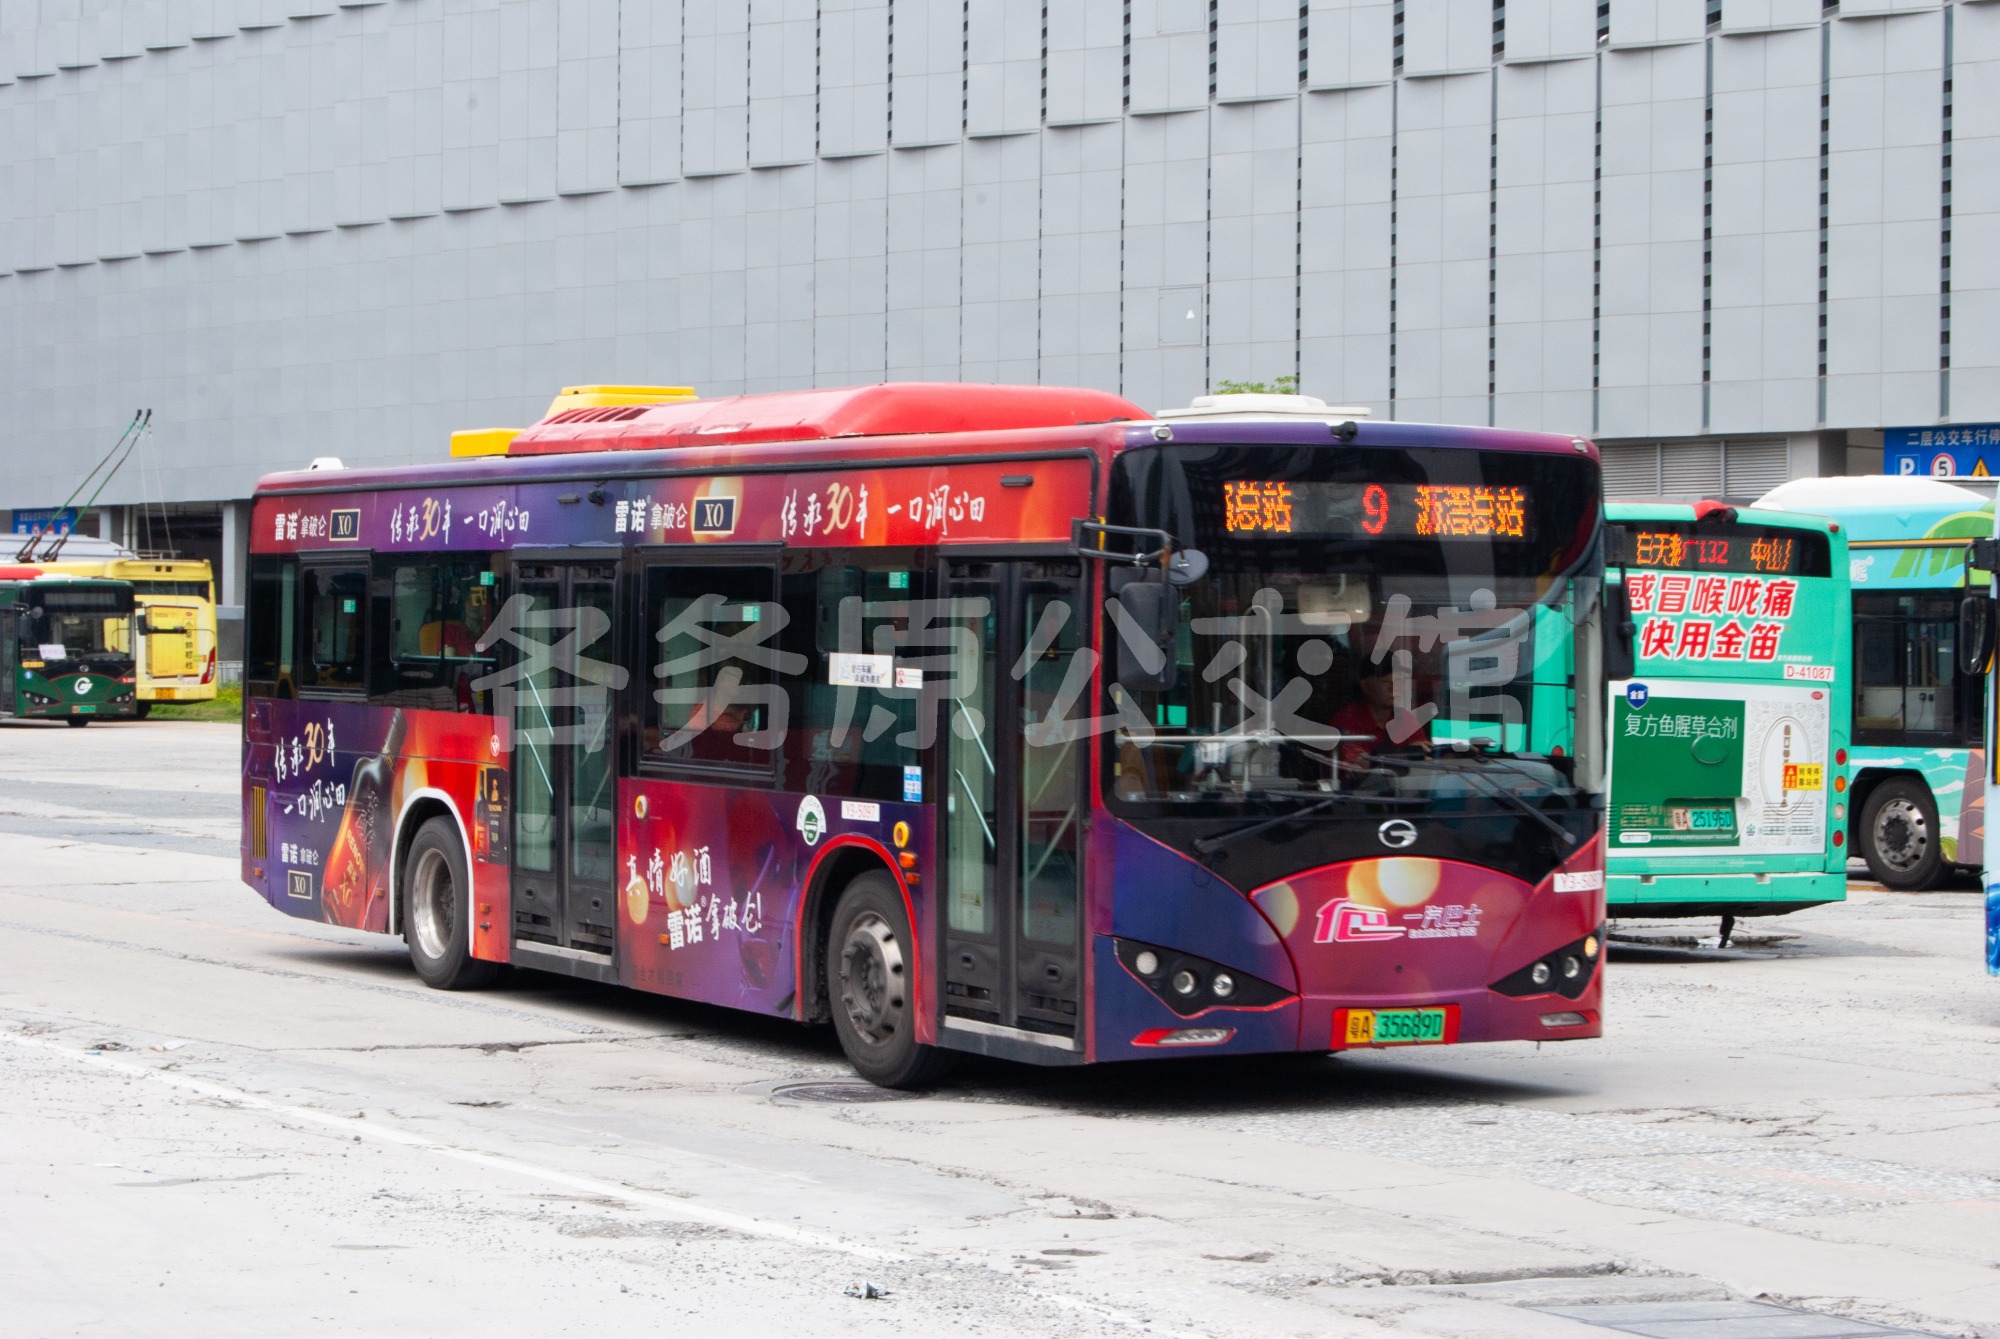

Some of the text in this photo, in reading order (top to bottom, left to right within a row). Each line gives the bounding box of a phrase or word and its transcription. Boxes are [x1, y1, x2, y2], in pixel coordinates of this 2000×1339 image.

[703, 503, 724, 528] XO
[1362, 484, 1389, 535] 9
[337, 514, 352, 537] XO
[1626, 572, 1797, 618] 感冒喉咙痛
[1641, 619, 1782, 661] 快用金笛
[1786, 665, 1832, 680] D-41087
[1624, 712, 1739, 740] 复方鱼腥草合剂
[294, 876, 306, 894] XO
[1402, 903, 1484, 929] 一汽巴士
